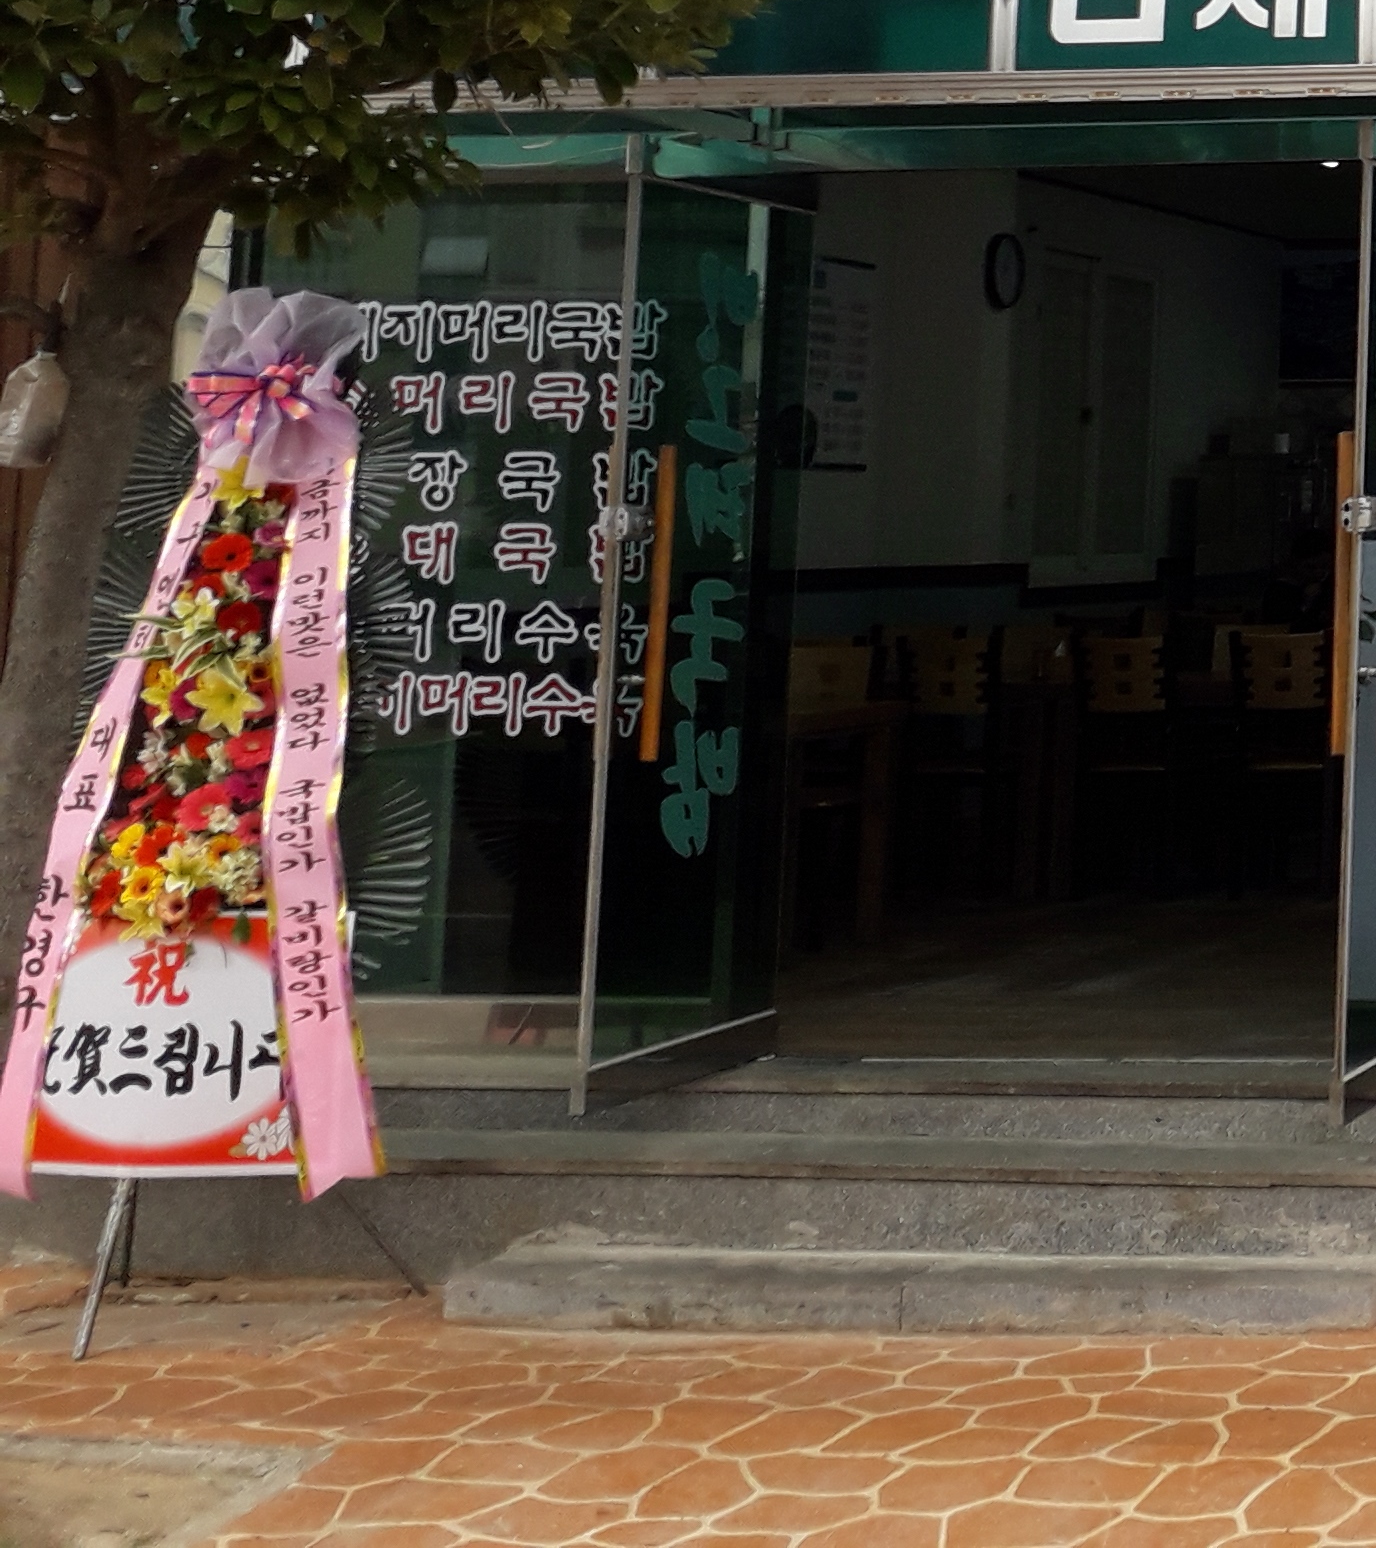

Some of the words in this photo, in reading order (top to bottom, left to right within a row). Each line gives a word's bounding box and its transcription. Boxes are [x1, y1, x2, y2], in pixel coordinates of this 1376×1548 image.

[346, 370, 664, 435] 머리국밥
[296, 458, 341, 543] 금까지
[123, 941, 191, 1006] 祝
